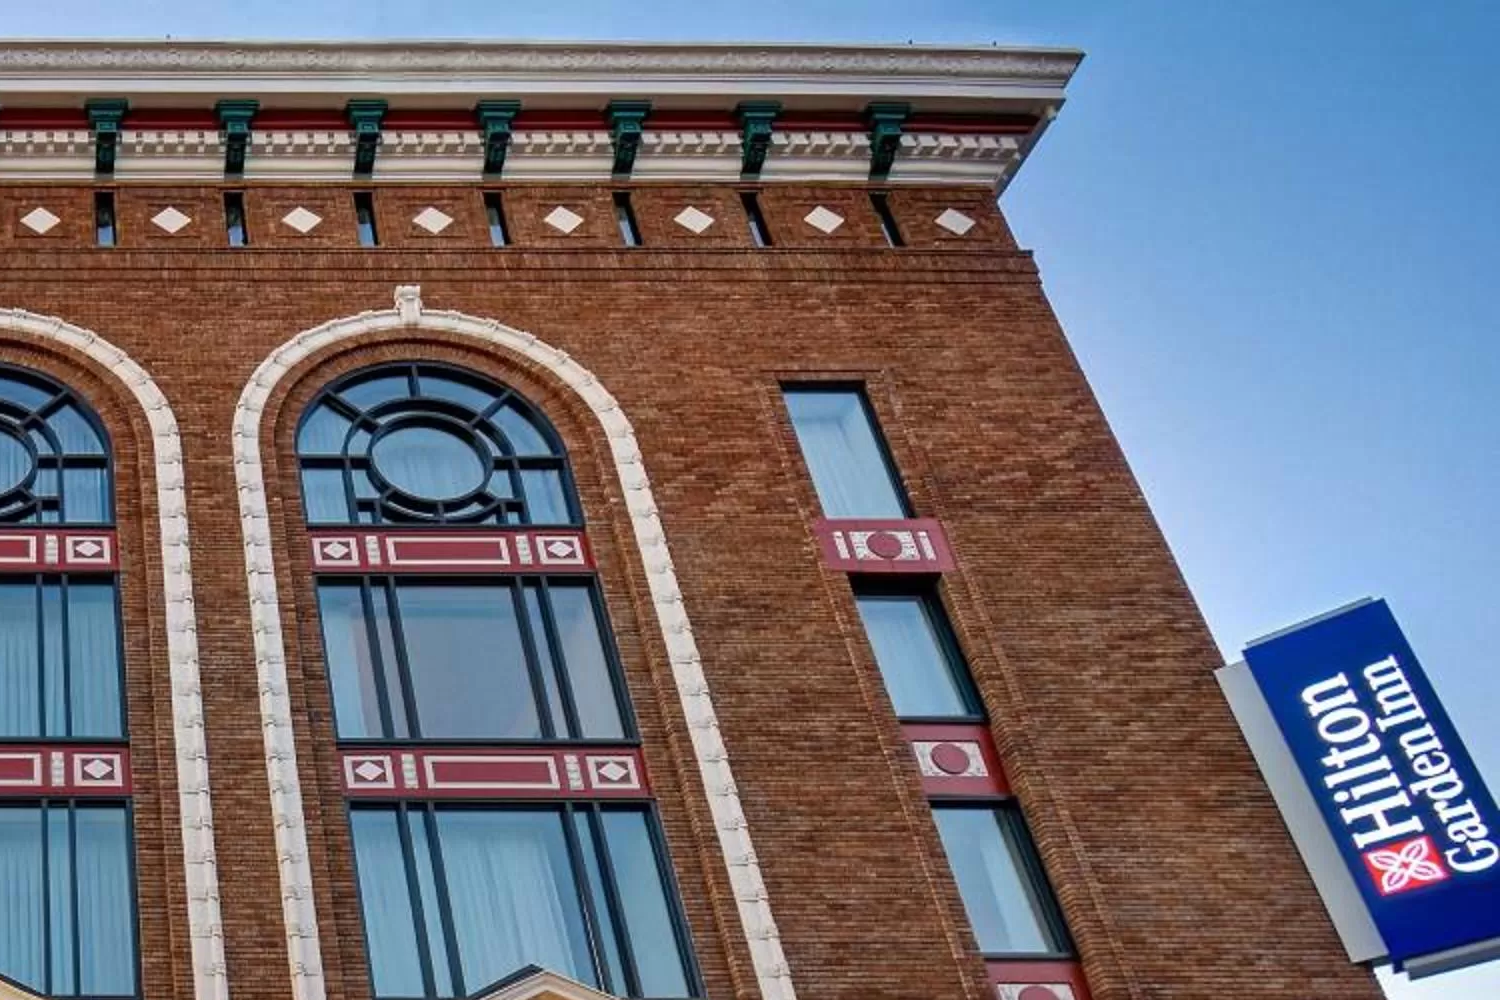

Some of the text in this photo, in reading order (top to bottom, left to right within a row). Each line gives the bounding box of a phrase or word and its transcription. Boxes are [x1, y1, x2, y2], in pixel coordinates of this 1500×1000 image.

[1301, 672, 1425, 849] Hilton
[1363, 654, 1500, 873] Garden Inn
